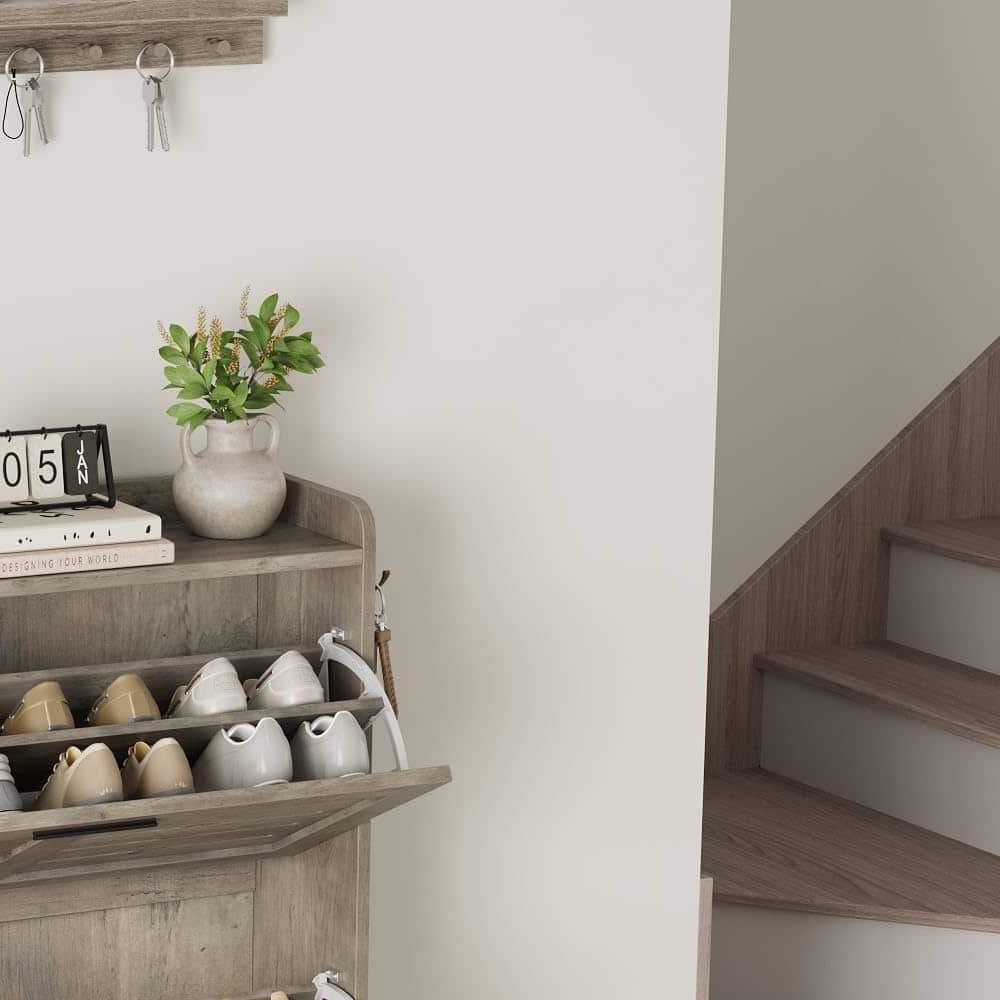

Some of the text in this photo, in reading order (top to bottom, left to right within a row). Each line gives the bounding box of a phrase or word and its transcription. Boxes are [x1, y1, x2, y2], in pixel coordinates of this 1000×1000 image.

[76, 439, 89, 485] JAN
[1, 553, 119, 573] DESIGNING YOUR WORLD
